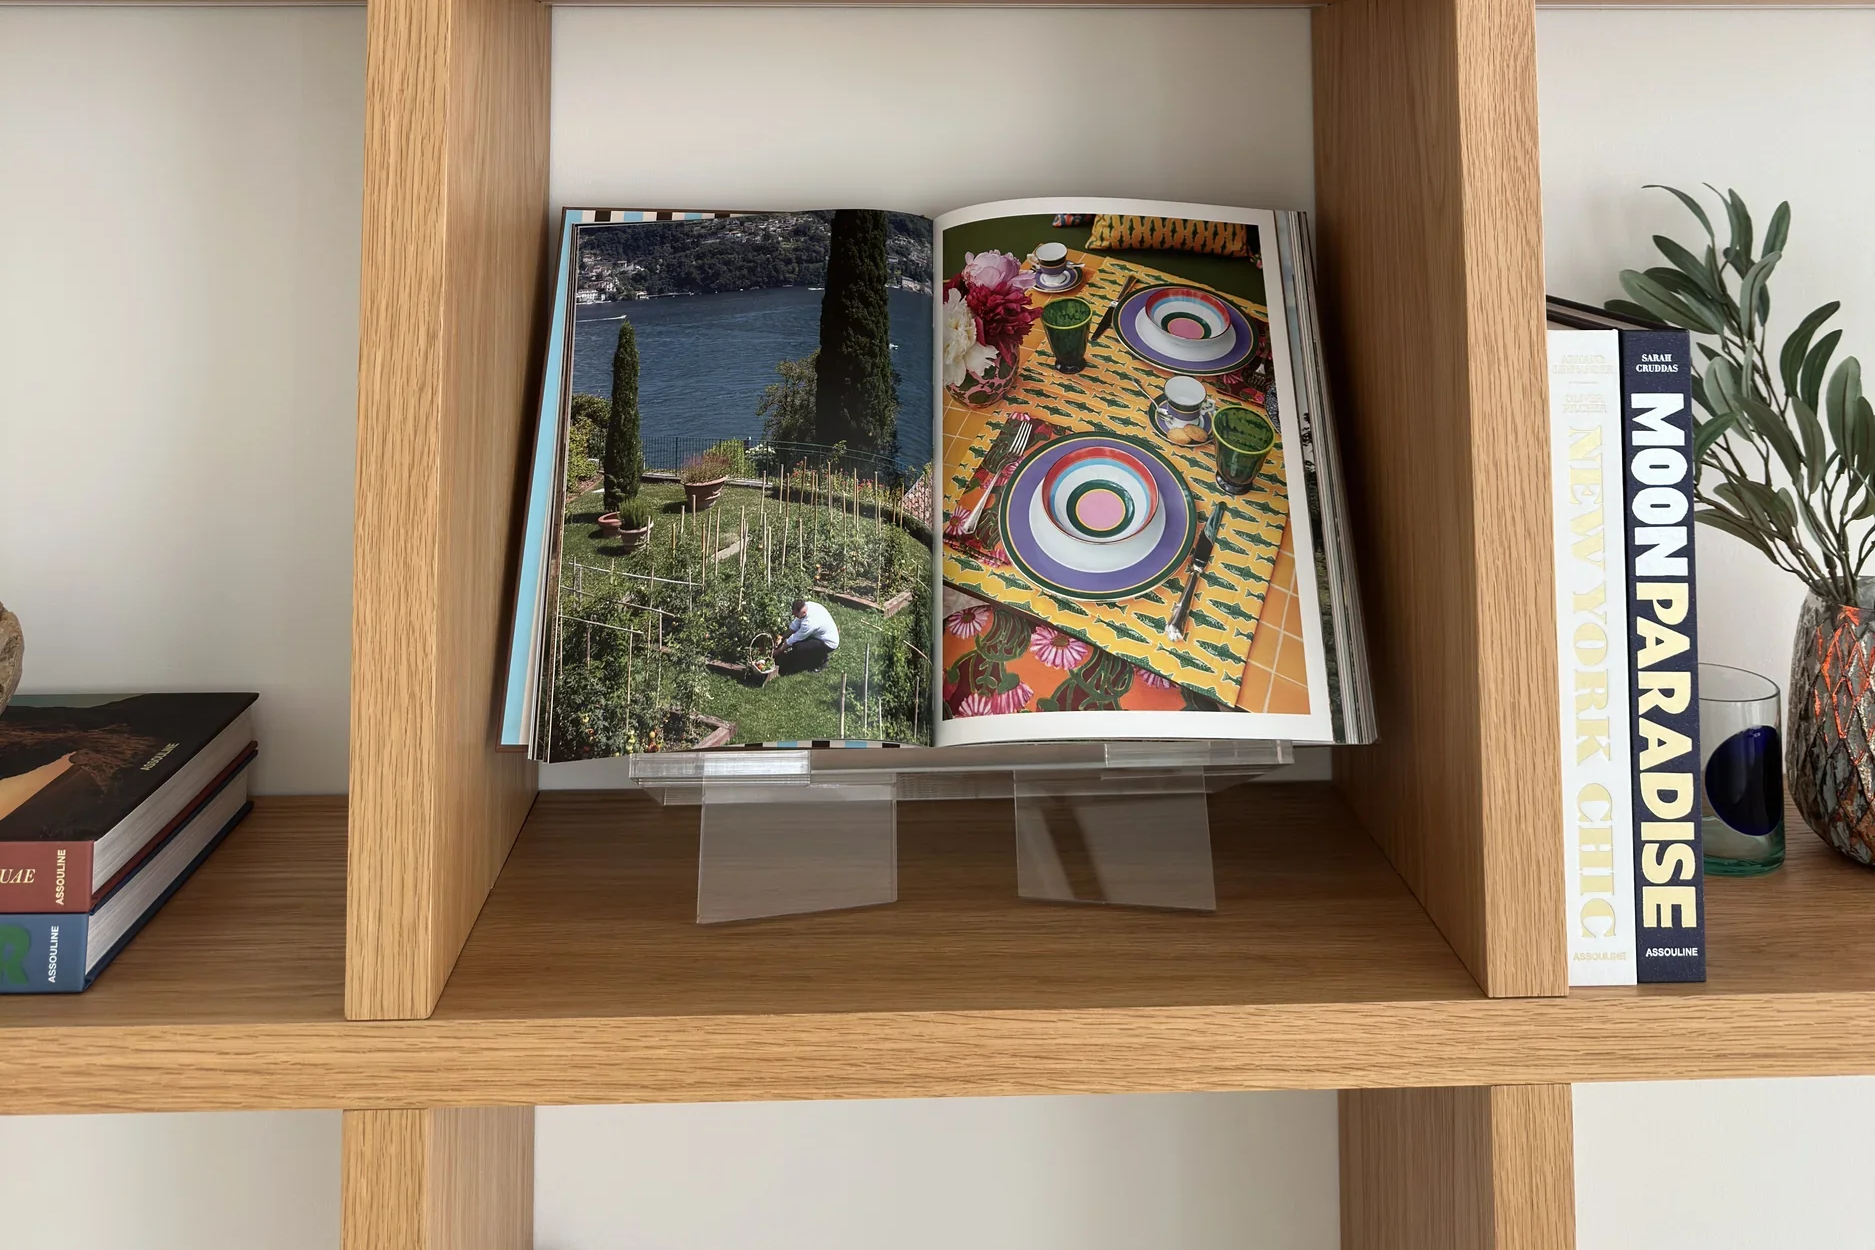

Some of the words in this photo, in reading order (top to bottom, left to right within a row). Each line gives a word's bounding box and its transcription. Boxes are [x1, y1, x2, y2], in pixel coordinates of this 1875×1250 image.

[1636, 363, 1678, 373] CRUDDAS
[1641, 353, 1672, 362] SARAH
[1568, 425, 1605, 572] NEW
[1573, 581, 1611, 767] YORK
[55, 849, 66, 905] ASSOULINE
[1576, 783, 1616, 939] CHIC
[48, 925, 59, 983] ASSOULINE
[1573, 951, 1626, 961] ASSOULINE
[1645, 947, 1698, 957] ASSOULINE
